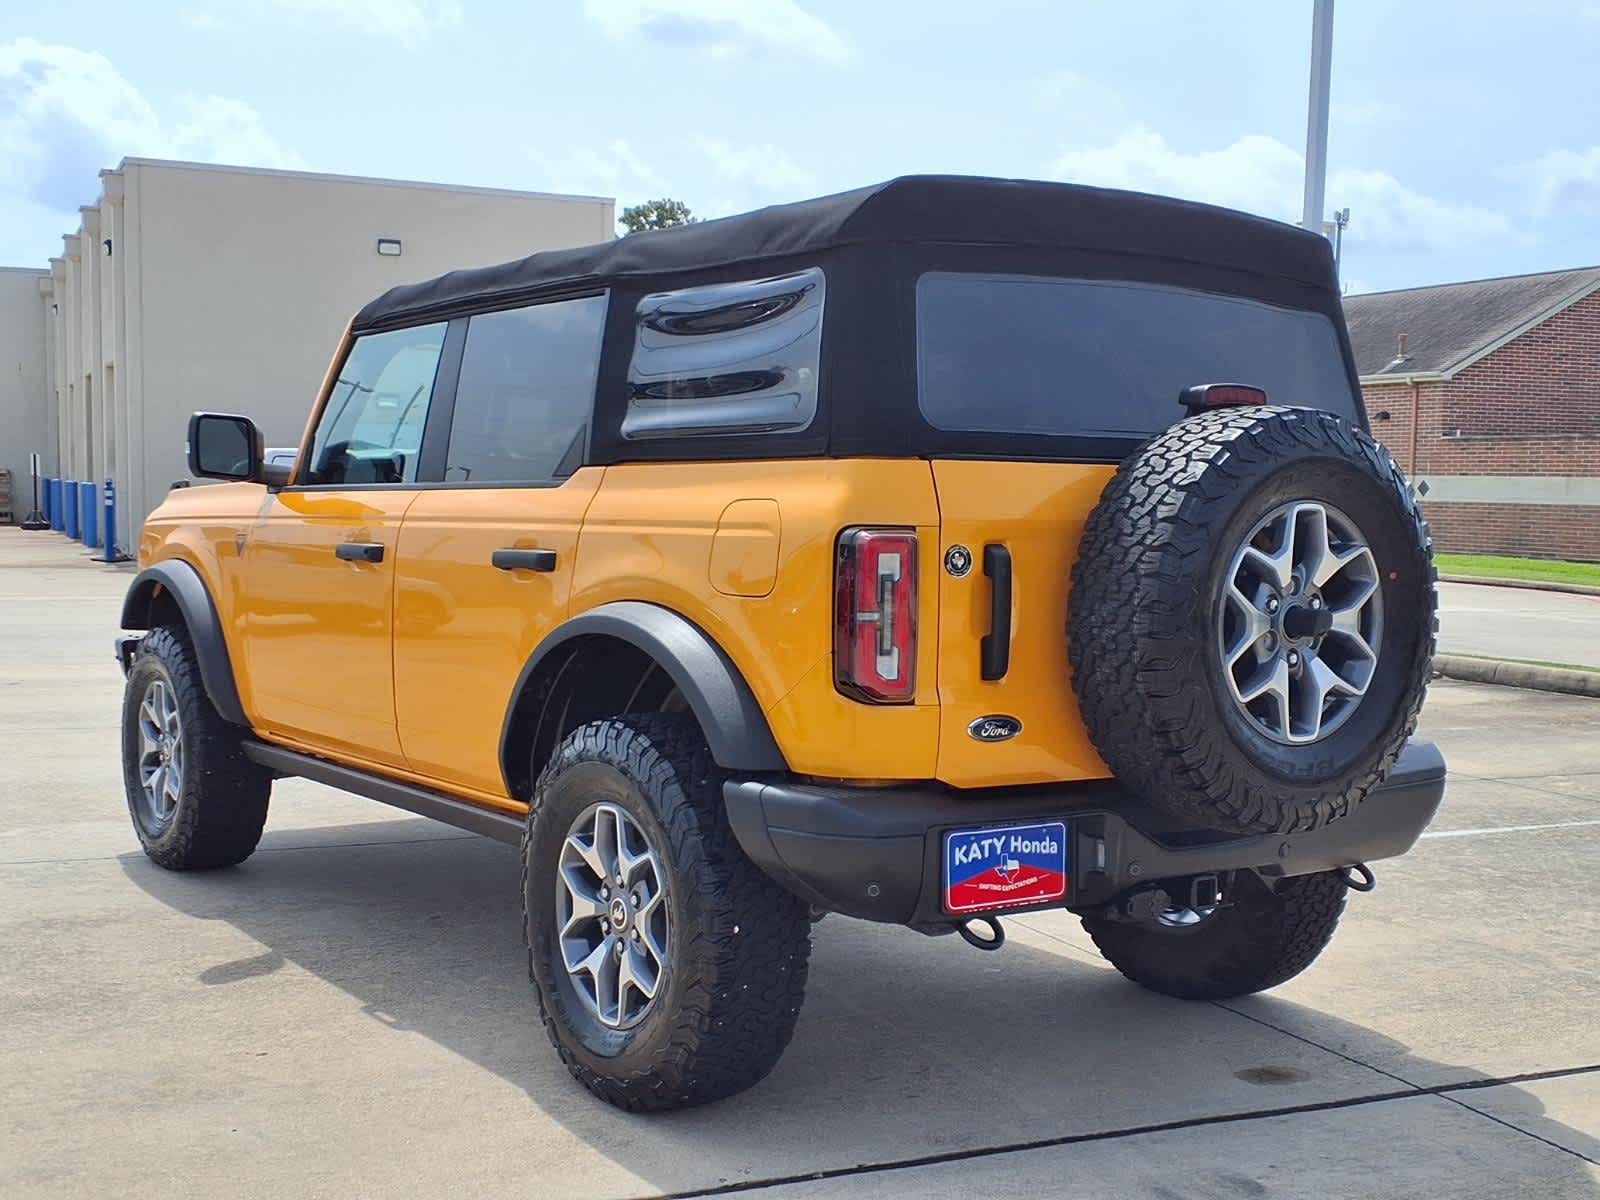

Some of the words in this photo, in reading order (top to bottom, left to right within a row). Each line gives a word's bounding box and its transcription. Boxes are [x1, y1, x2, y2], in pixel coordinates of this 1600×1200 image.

[981, 721, 1010, 736] Ford
[955, 836, 1006, 866] KATY
[1010, 835, 1058, 854] Honda
